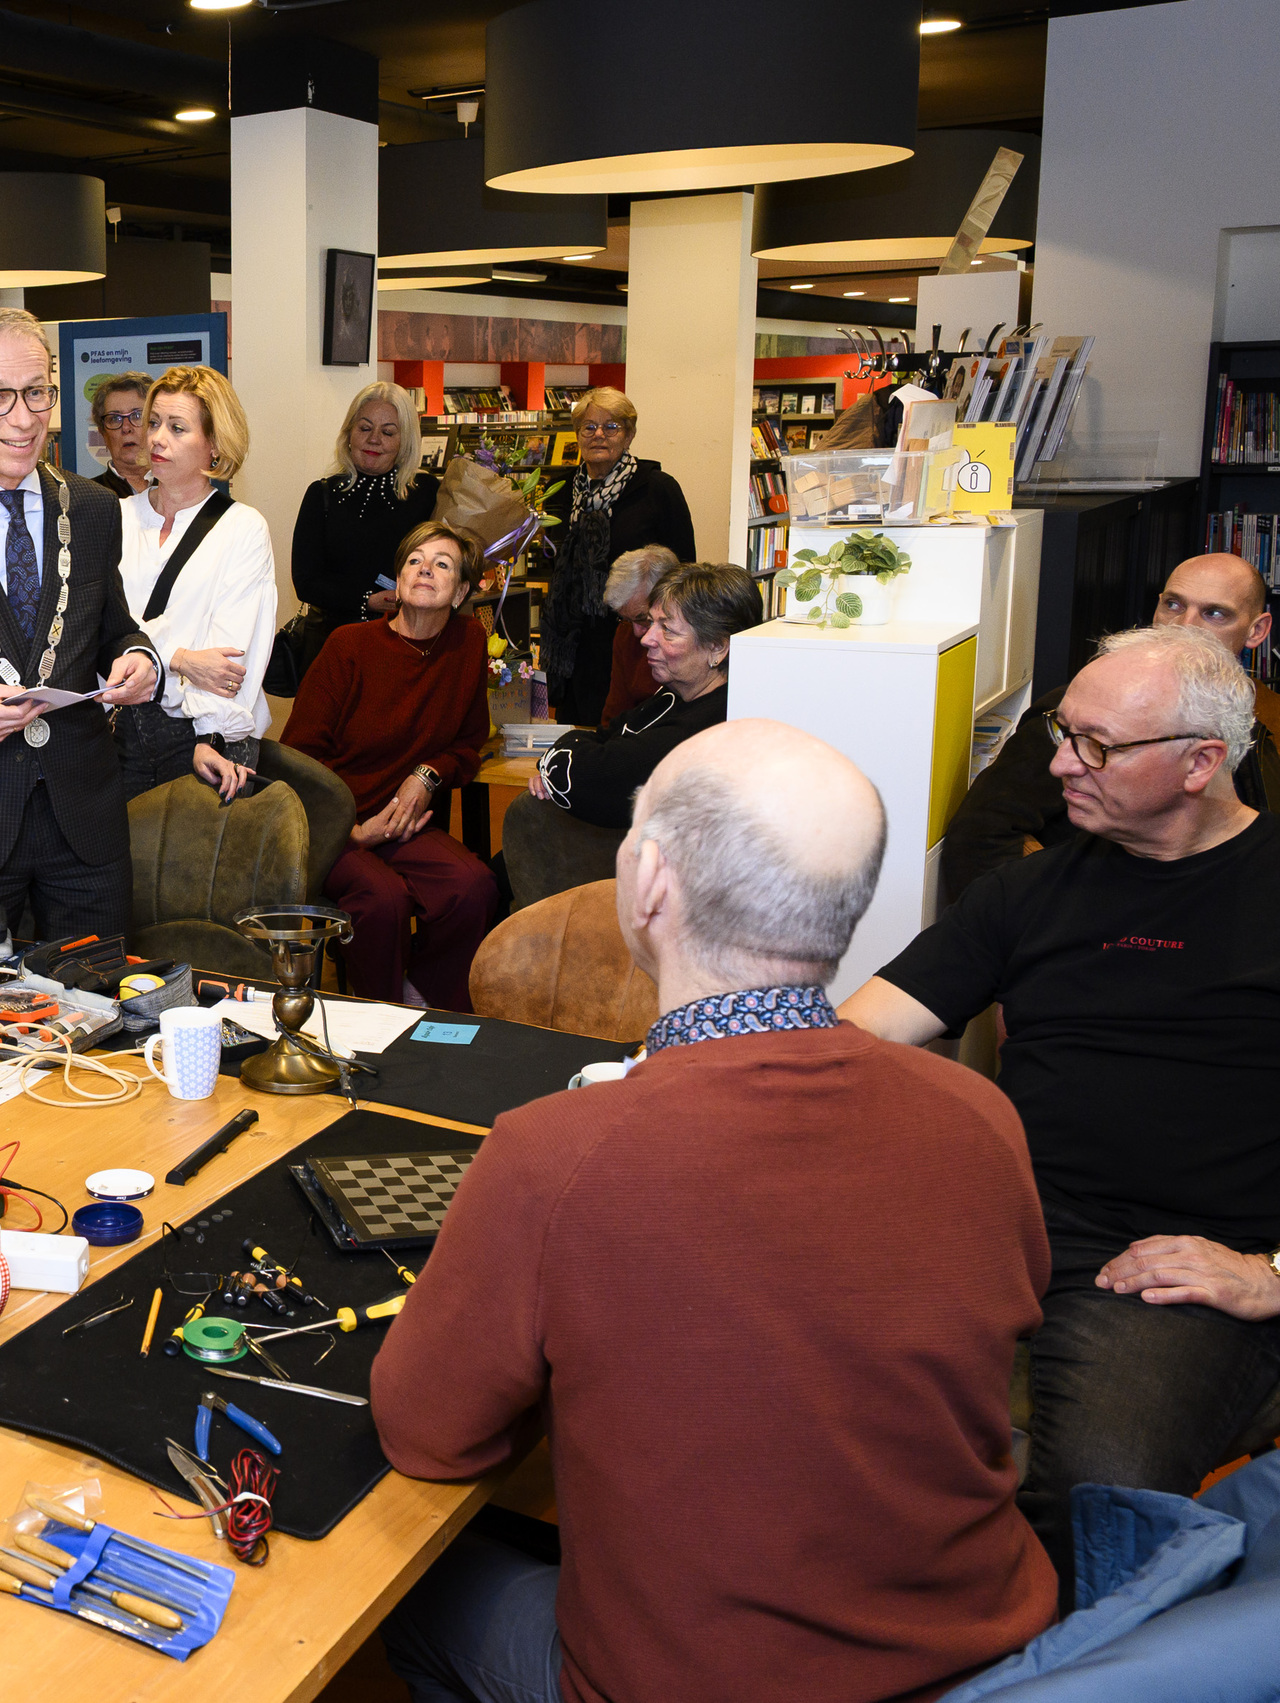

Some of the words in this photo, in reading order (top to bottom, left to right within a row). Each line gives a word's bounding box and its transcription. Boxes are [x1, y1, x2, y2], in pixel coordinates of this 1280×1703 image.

[114, 349, 128, 358] mijn
[90, 355, 132, 365] leefomgeving
[1129, 936, 1185, 950] COUTURE
